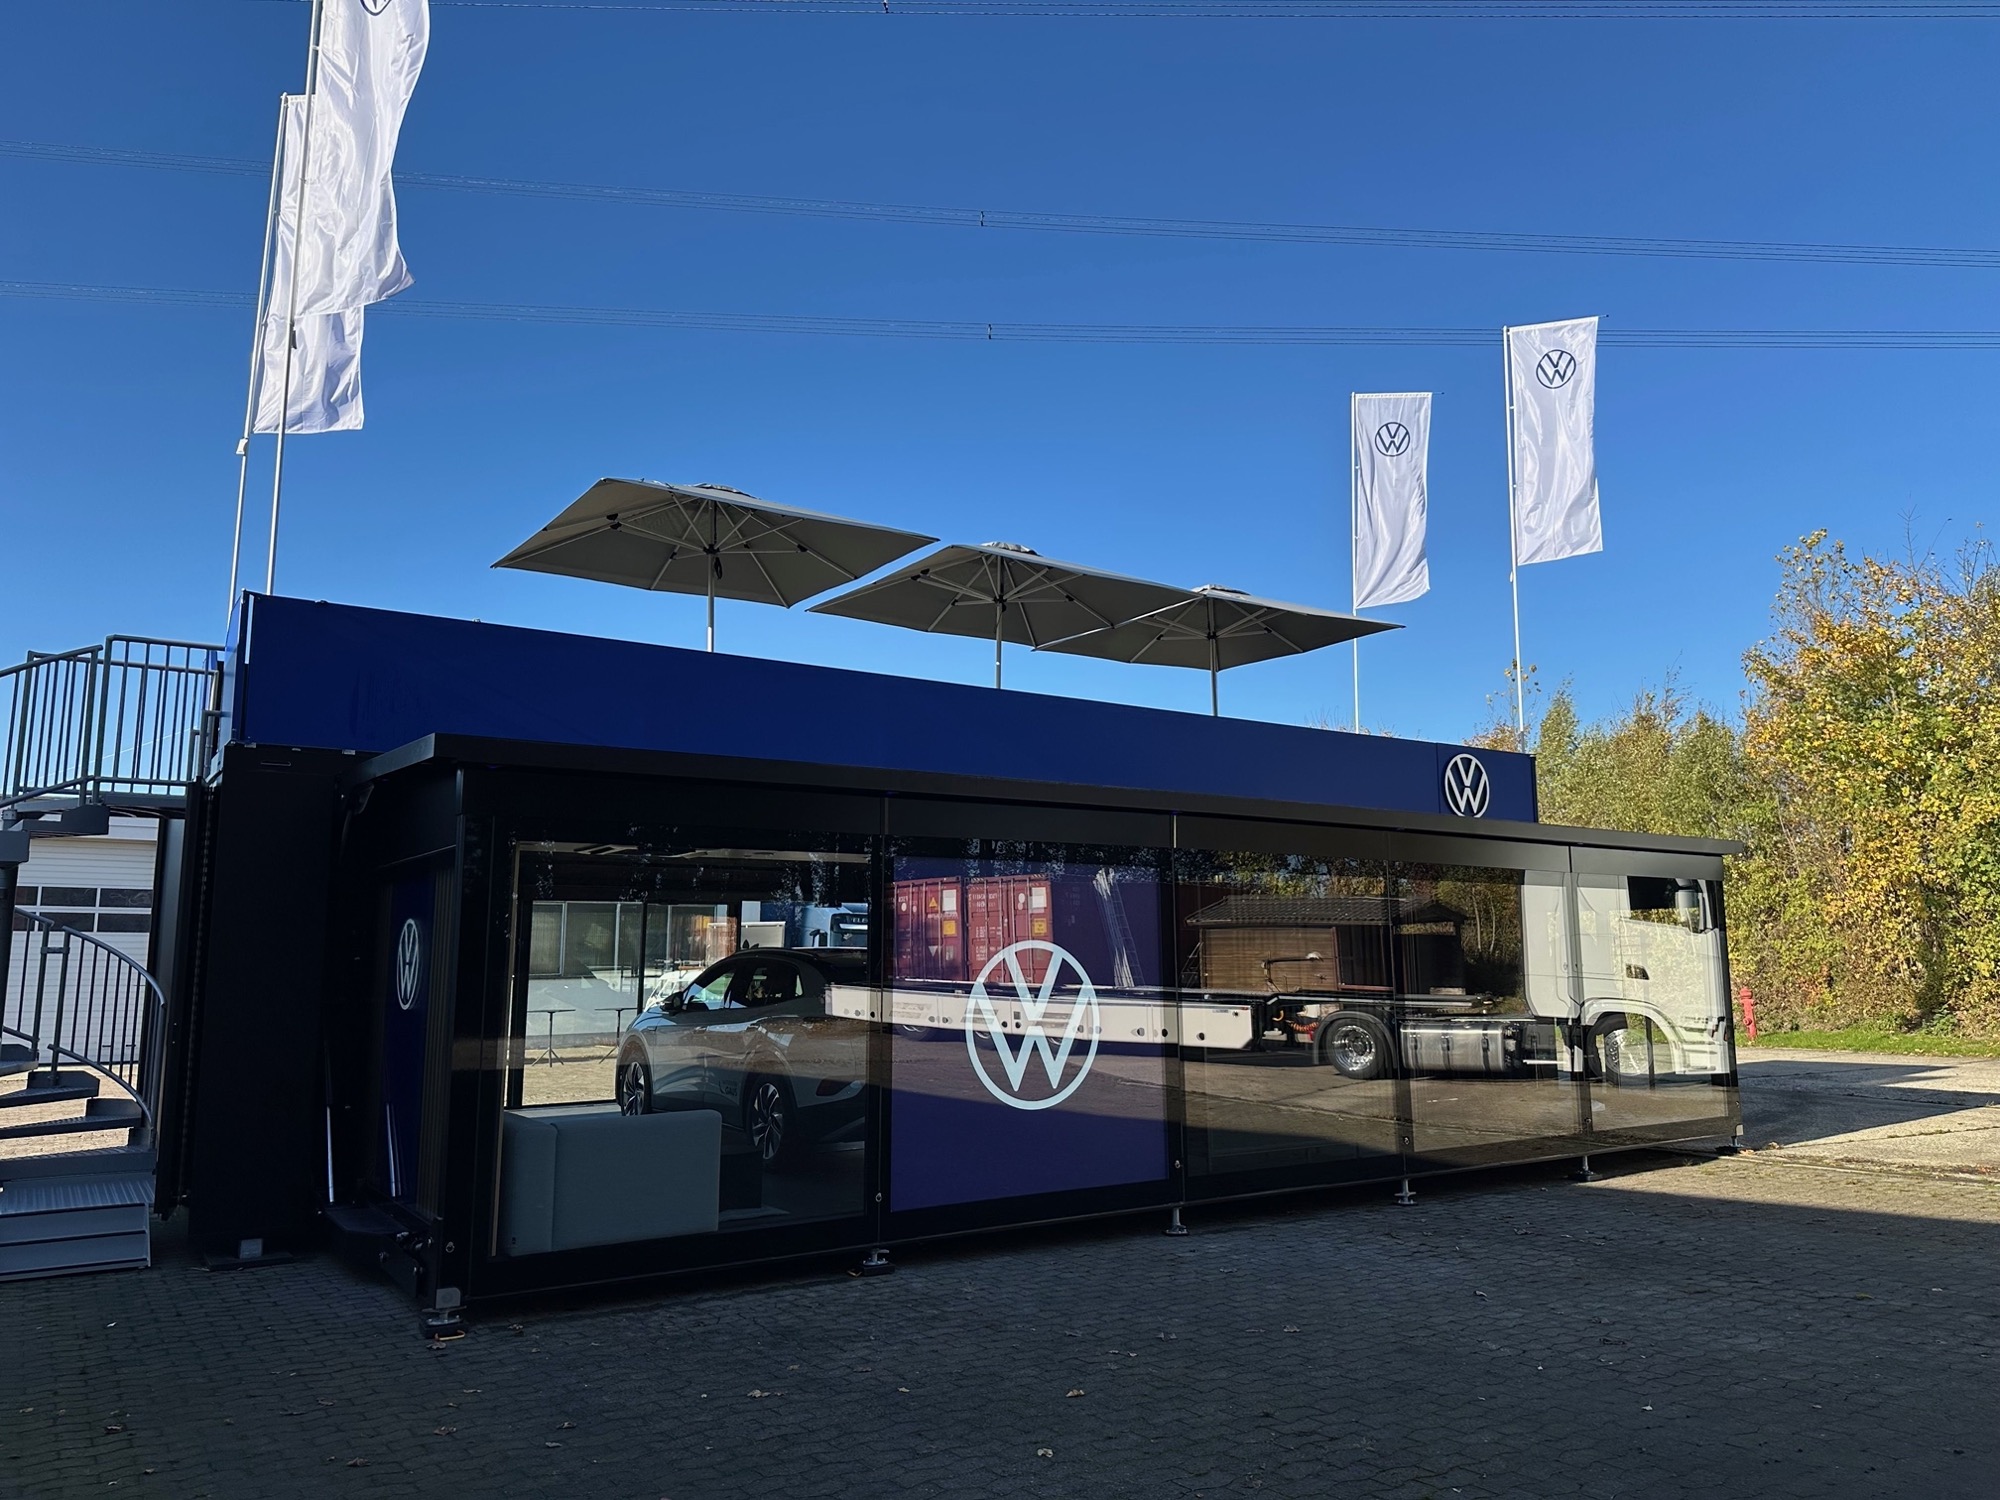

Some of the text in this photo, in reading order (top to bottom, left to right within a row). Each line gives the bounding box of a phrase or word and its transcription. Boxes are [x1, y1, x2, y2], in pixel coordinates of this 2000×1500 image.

[1538, 350, 1575, 386] VW
[1376, 423, 1409, 454] VW
[1447, 756, 1487, 814] VW
[399, 920, 418, 1001] VW
[971, 944, 1096, 1096] VW
